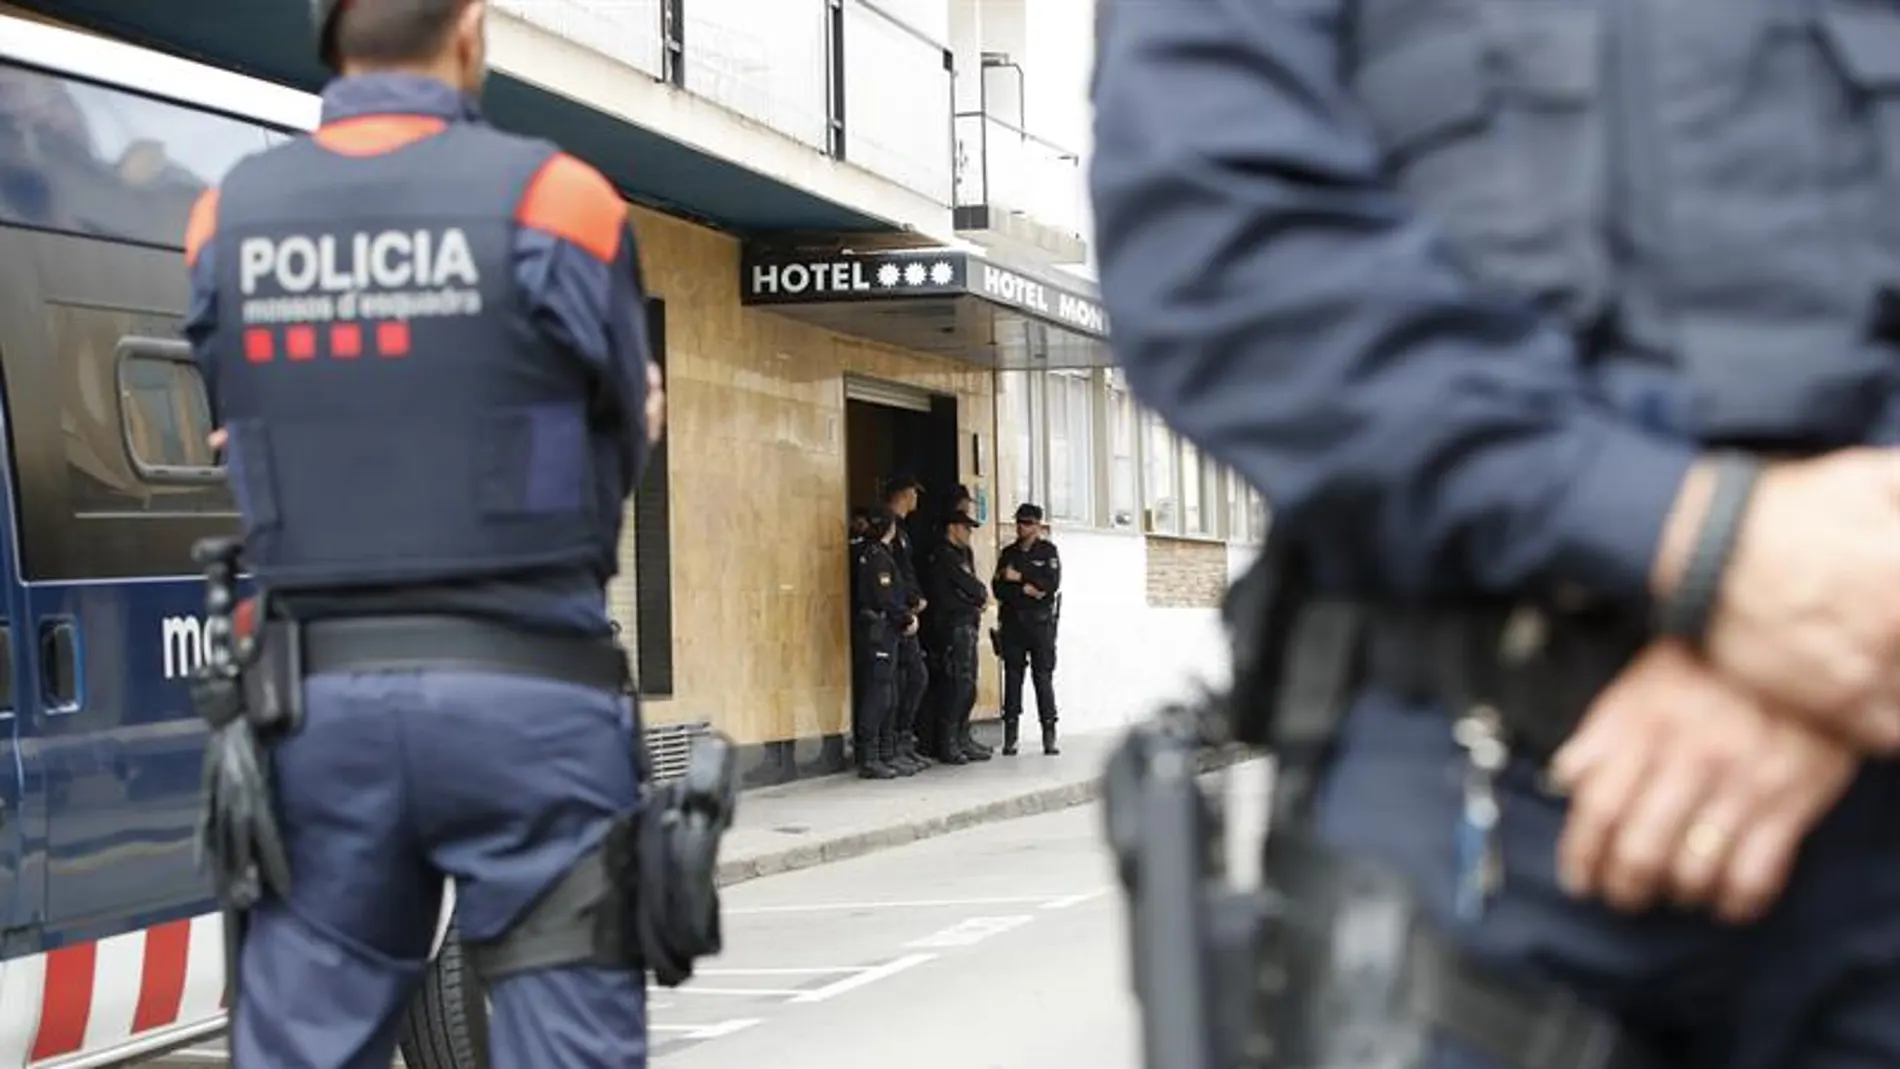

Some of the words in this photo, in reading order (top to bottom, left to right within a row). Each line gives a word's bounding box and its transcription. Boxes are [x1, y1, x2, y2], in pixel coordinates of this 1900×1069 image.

[240, 228, 478, 295] POLICIA
[752, 262, 869, 293] HOTEL
[984, 264, 1048, 313] HOTEL
[1059, 293, 1110, 333] MON
